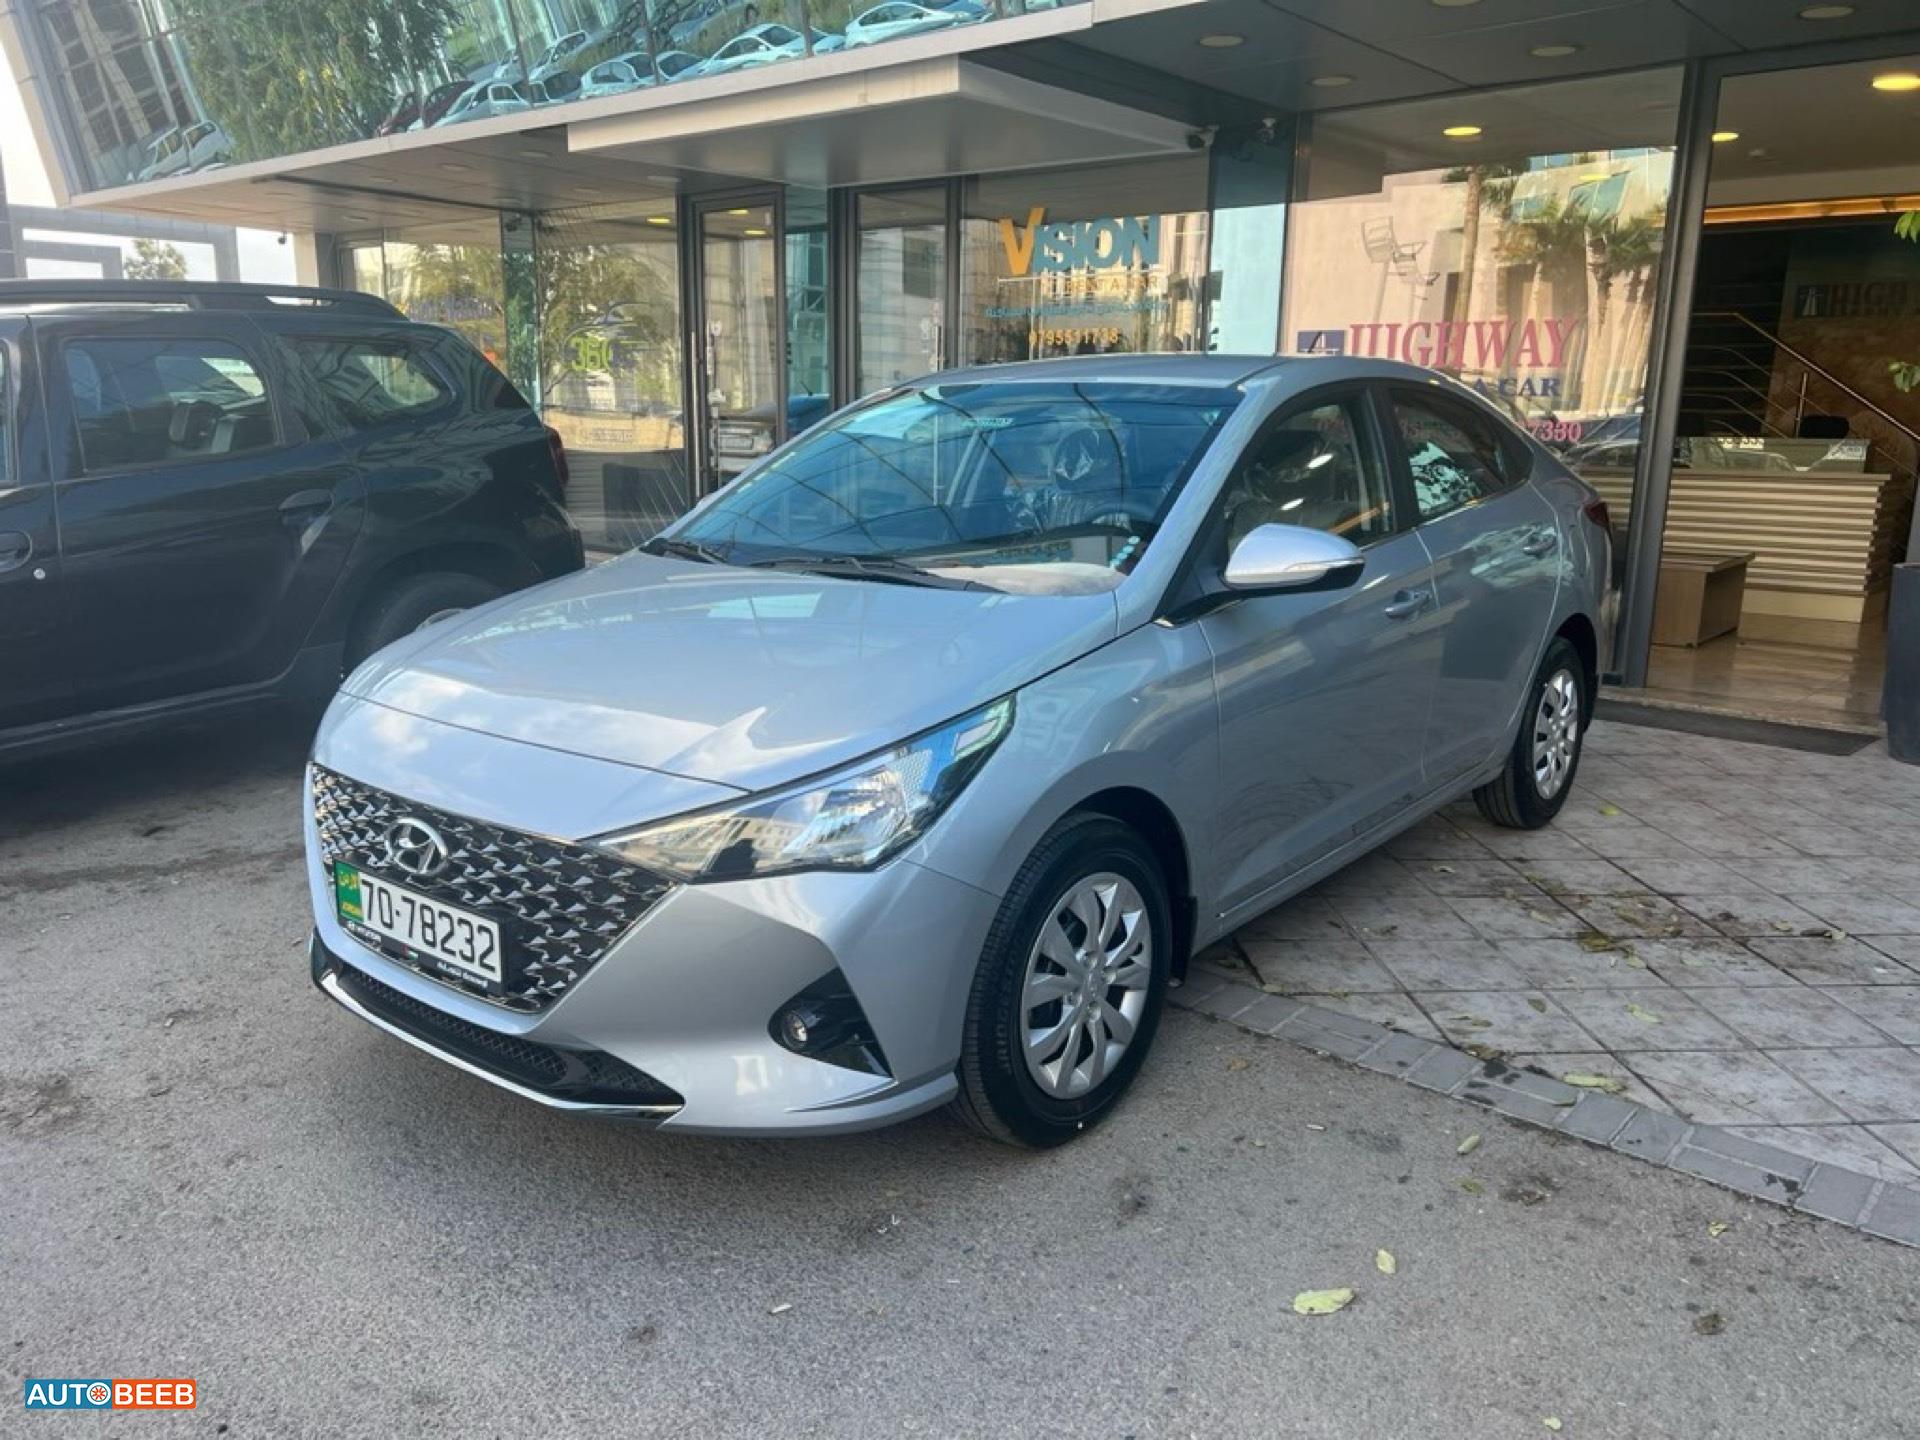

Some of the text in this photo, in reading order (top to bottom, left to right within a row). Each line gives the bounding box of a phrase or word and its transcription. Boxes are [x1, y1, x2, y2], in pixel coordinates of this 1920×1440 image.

[999, 207, 1160, 275] VISION
[1350, 318, 1579, 369] HIGHWAY
[1498, 378, 1560, 397] CAR
[1522, 420, 1582, 442] 7330
[361, 879, 496, 974] 70-78232
